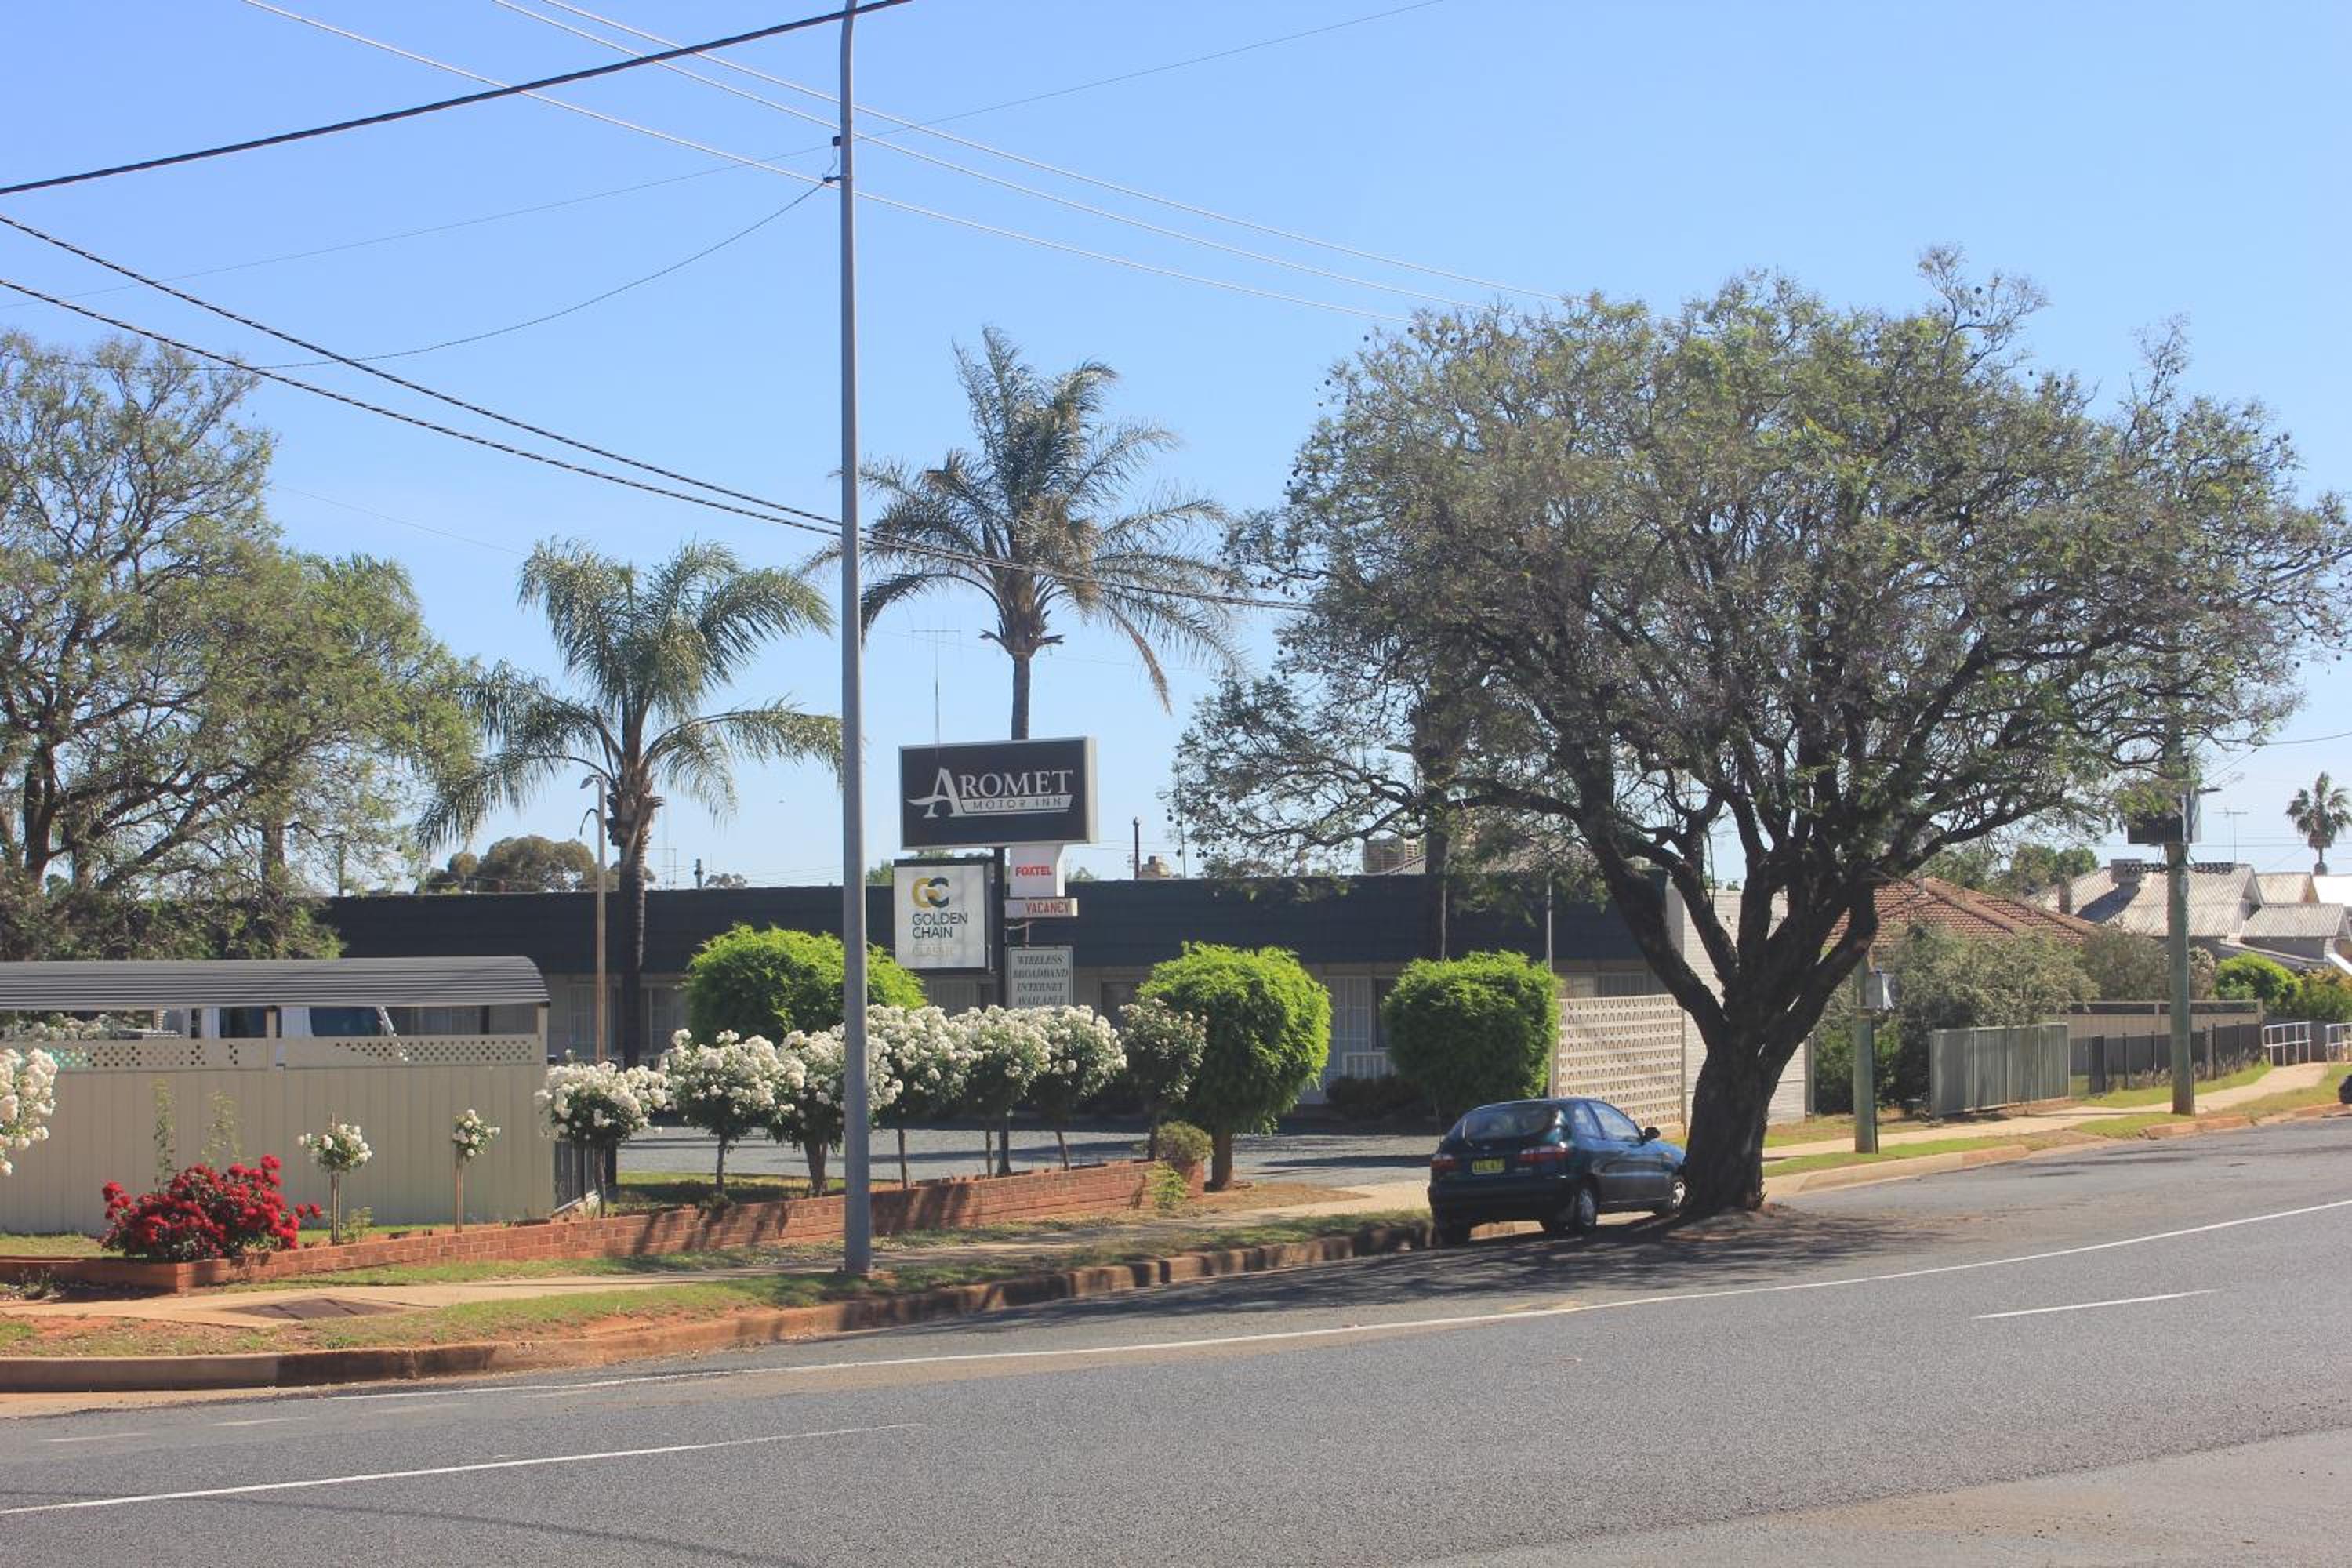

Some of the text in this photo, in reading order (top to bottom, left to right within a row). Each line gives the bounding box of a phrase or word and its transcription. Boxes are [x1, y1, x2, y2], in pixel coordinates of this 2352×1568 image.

[907, 767, 1073, 818] AROMET
[973, 797, 1062, 810] MOTOR INN
[1015, 866, 1052, 877] FOXTEL
[1025, 901, 1071, 915] VACANCY
[912, 913, 968, 925] GOLDEN
[912, 927, 953, 939] CHAIN
[1017, 954, 1065, 965] WIRELESS
[1013, 968, 1069, 979] BROADBAND
[1017, 982, 1065, 992] INTERNET
